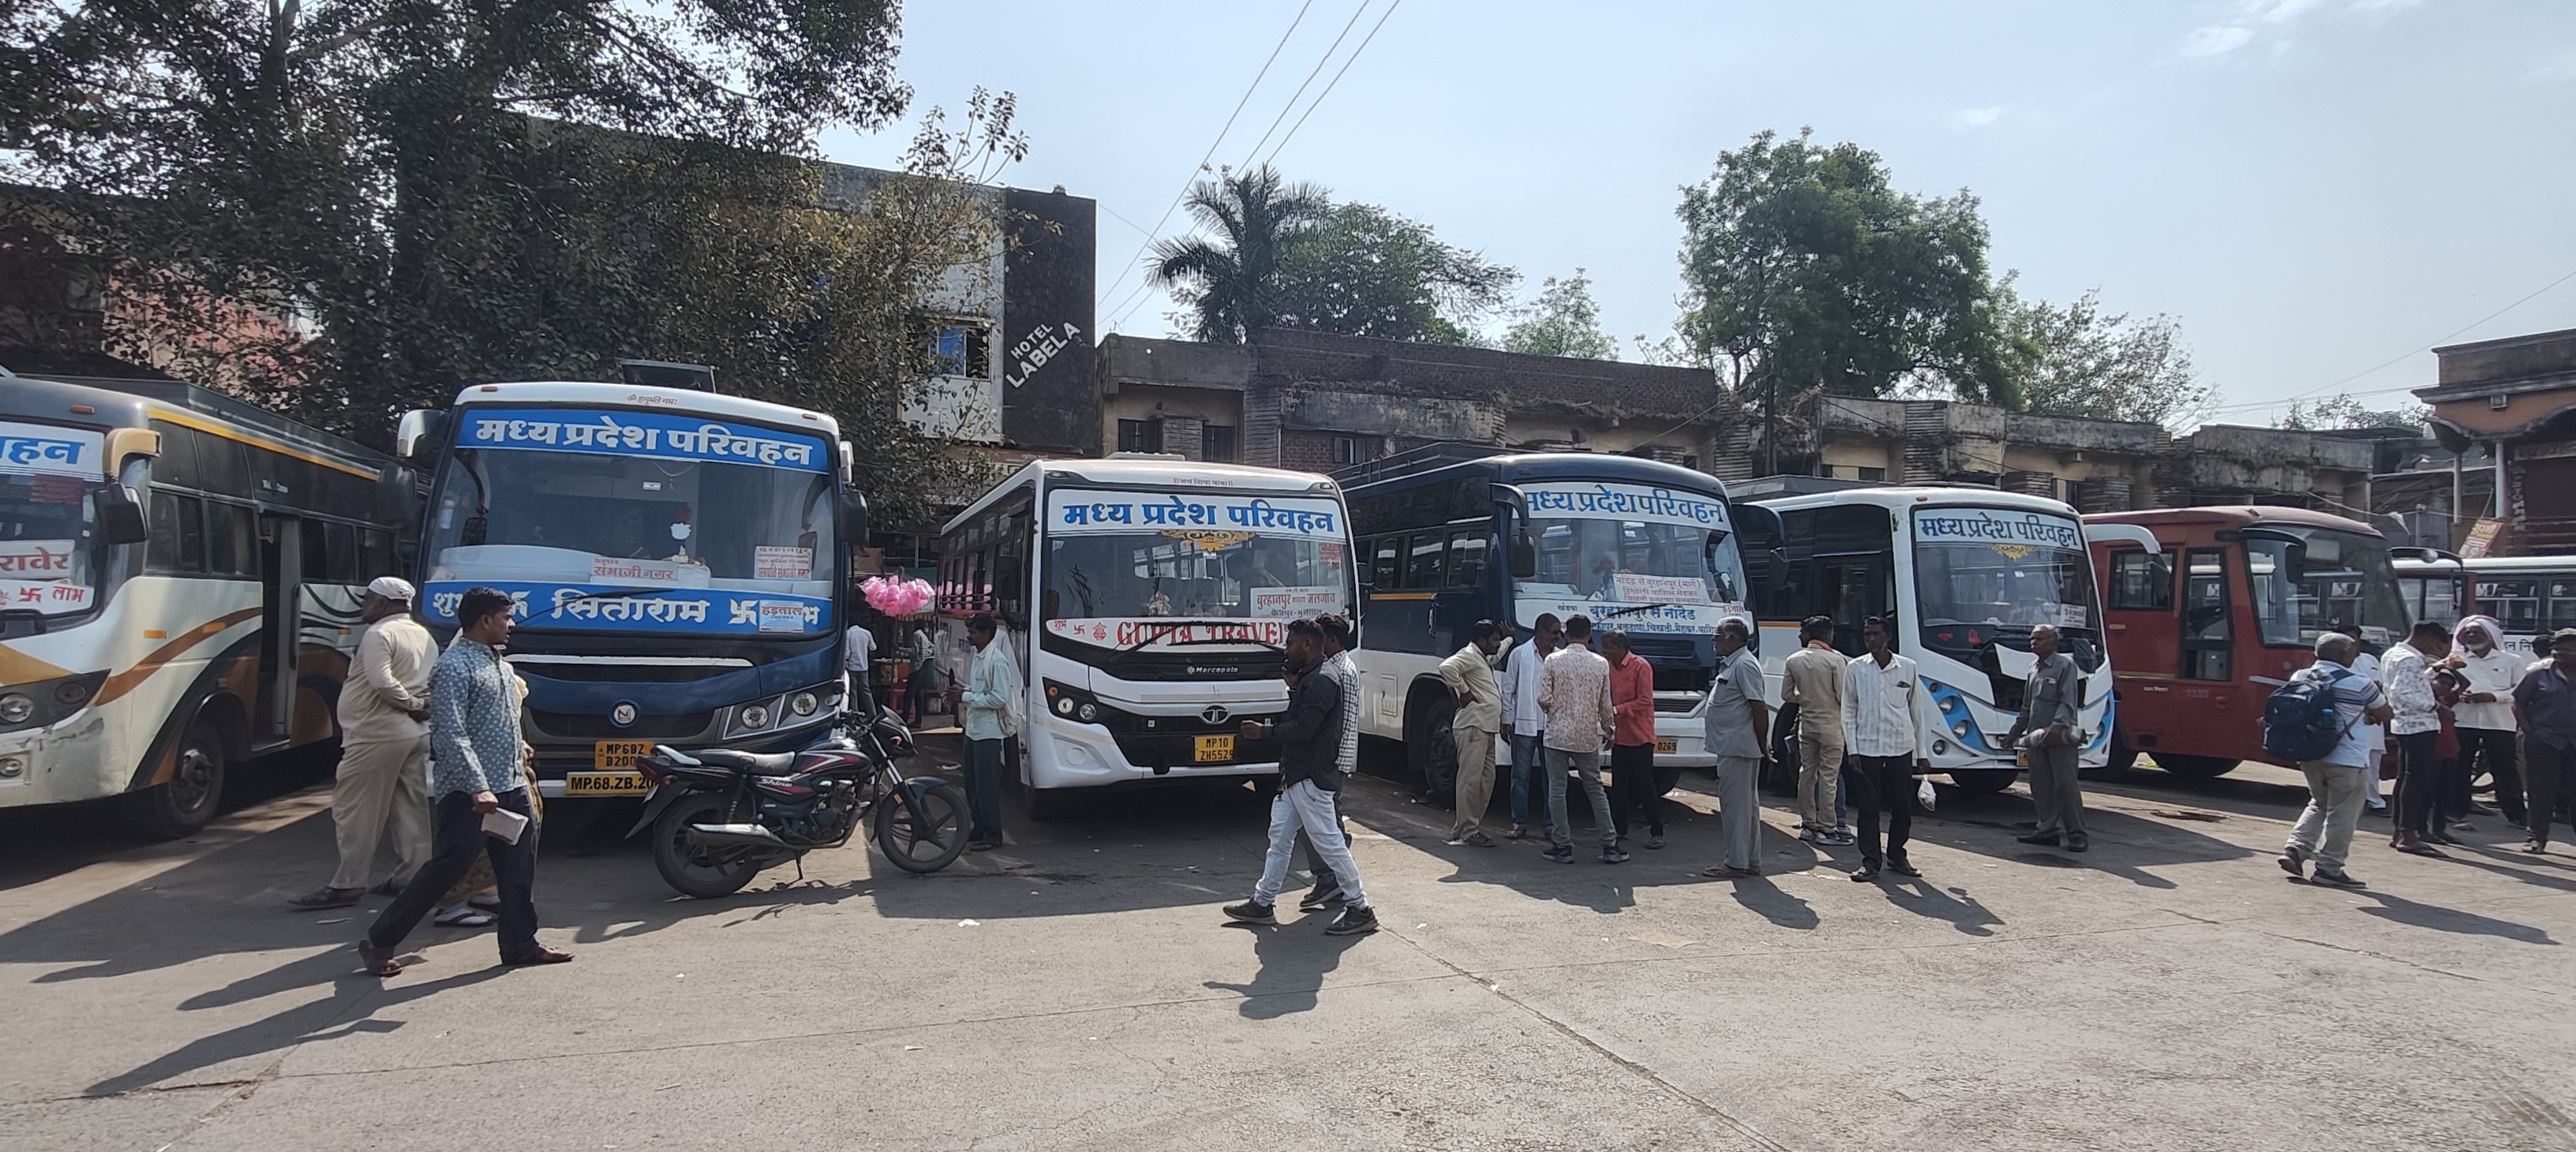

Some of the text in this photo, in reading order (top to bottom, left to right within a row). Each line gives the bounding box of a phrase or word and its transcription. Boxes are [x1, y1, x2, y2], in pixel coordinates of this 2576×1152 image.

[1005, 322, 1080, 388] LABELA
[1010, 324, 1053, 360] HOTEL
[476, 415, 813, 465] मध्य प्रदेश परिवहन
[1063, 496, 1335, 533] मध्य प्रदेश परिवहन
[1638, 488, 1724, 523] परिवहन
[1919, 511, 2078, 547] मध्य प्रदेश परिवहन
[52, 585, 84, 603] लाभ
[552, 589, 710, 623] सिताराम
[1118, 622, 1193, 645] GUPTA
[1206, 737, 1229, 748] MP10
[761, 778, 792, 787] Shine
